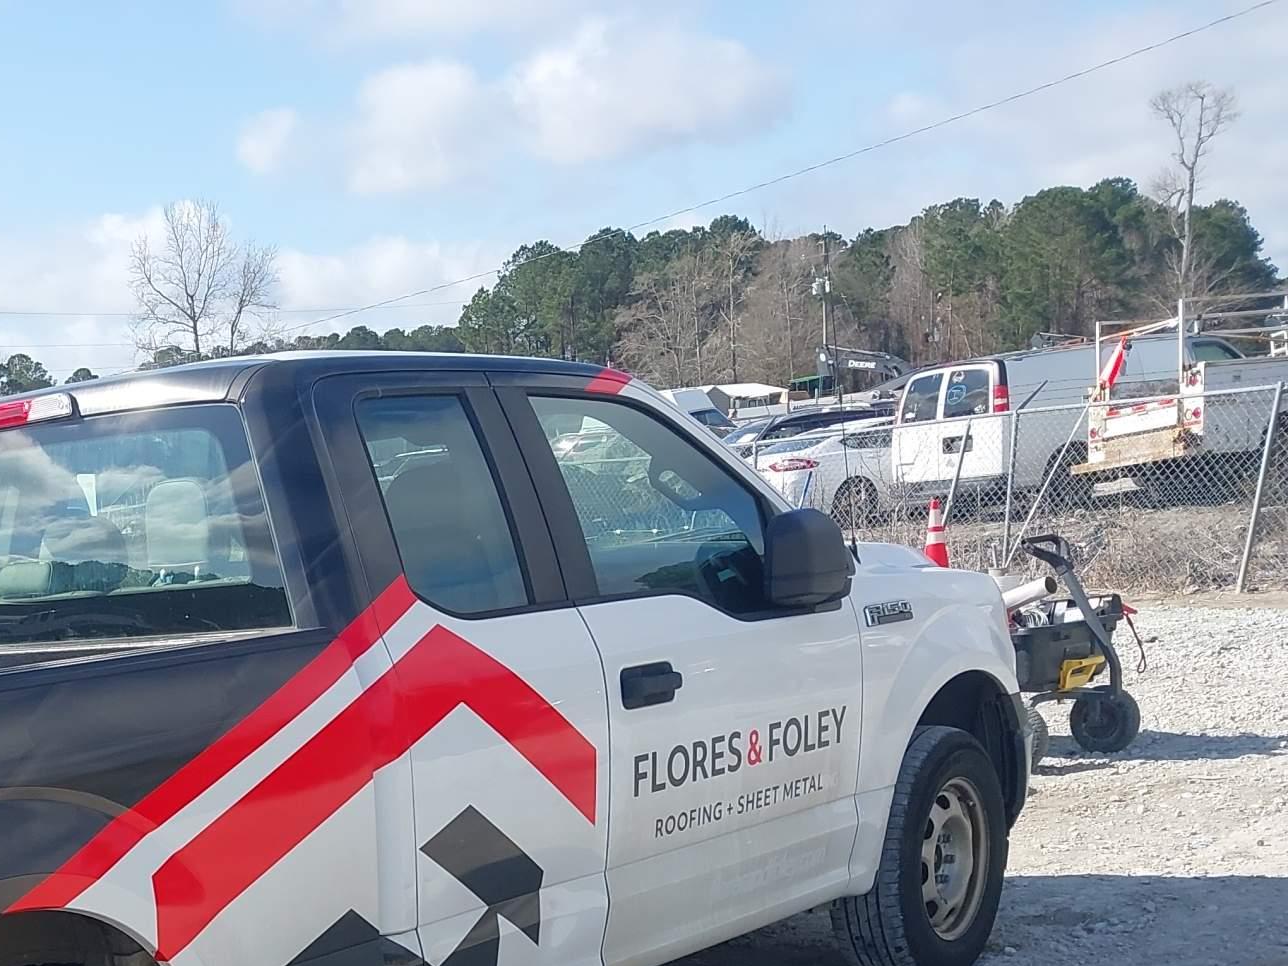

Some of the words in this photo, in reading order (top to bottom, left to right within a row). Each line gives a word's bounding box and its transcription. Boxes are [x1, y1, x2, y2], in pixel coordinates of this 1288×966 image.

[848, 359, 877, 369] DEERE
[633, 731, 742, 798] FLORES
[747, 729, 763, 766] &
[768, 705, 847, 762] FOLEY
[655, 802, 723, 838] ROOFING
[736, 785, 780, 815] SHEET
[782, 773, 824, 802] METAL
